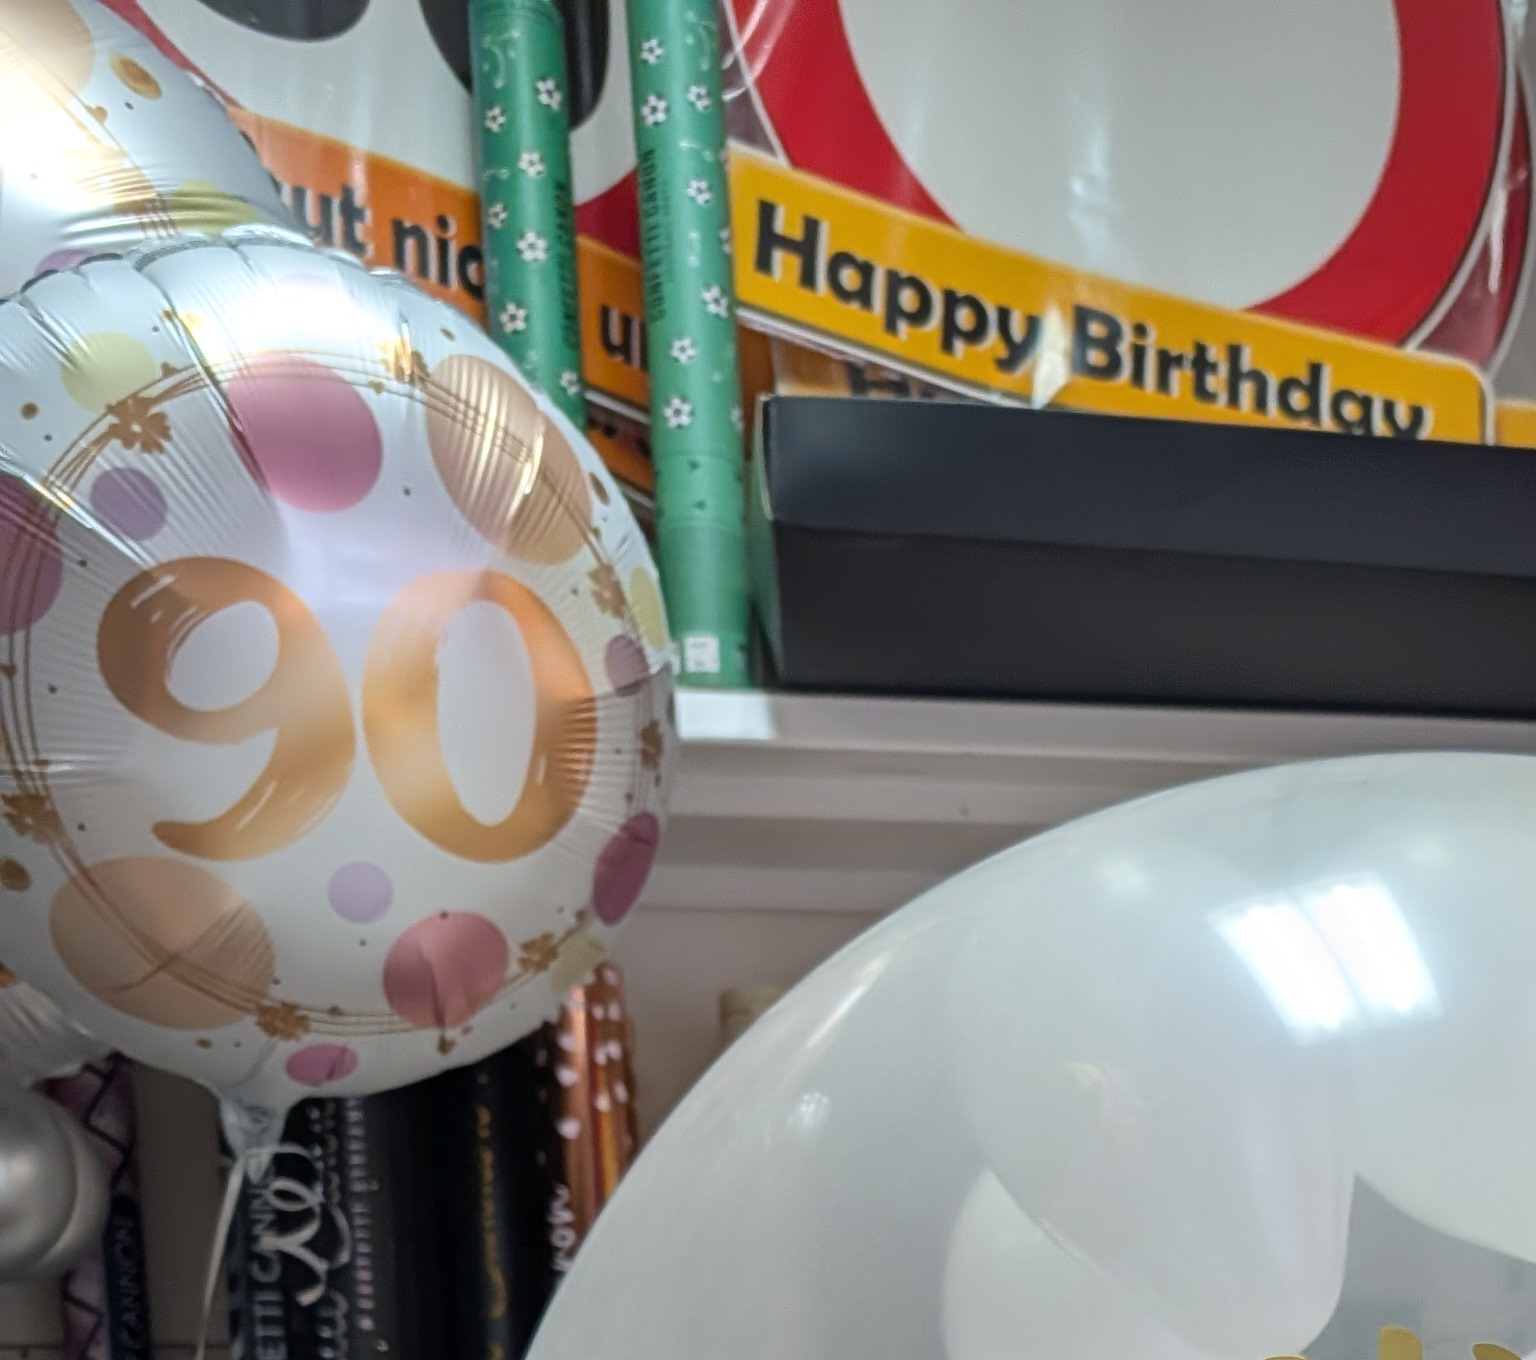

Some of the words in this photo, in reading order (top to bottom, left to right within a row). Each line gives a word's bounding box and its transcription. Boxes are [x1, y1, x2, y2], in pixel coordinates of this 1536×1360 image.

[272, 172, 366, 258] ut
[753, 199, 1042, 376] Happy
[1071, 303, 1432, 440] Birthday
[97, 556, 598, 863] 90
